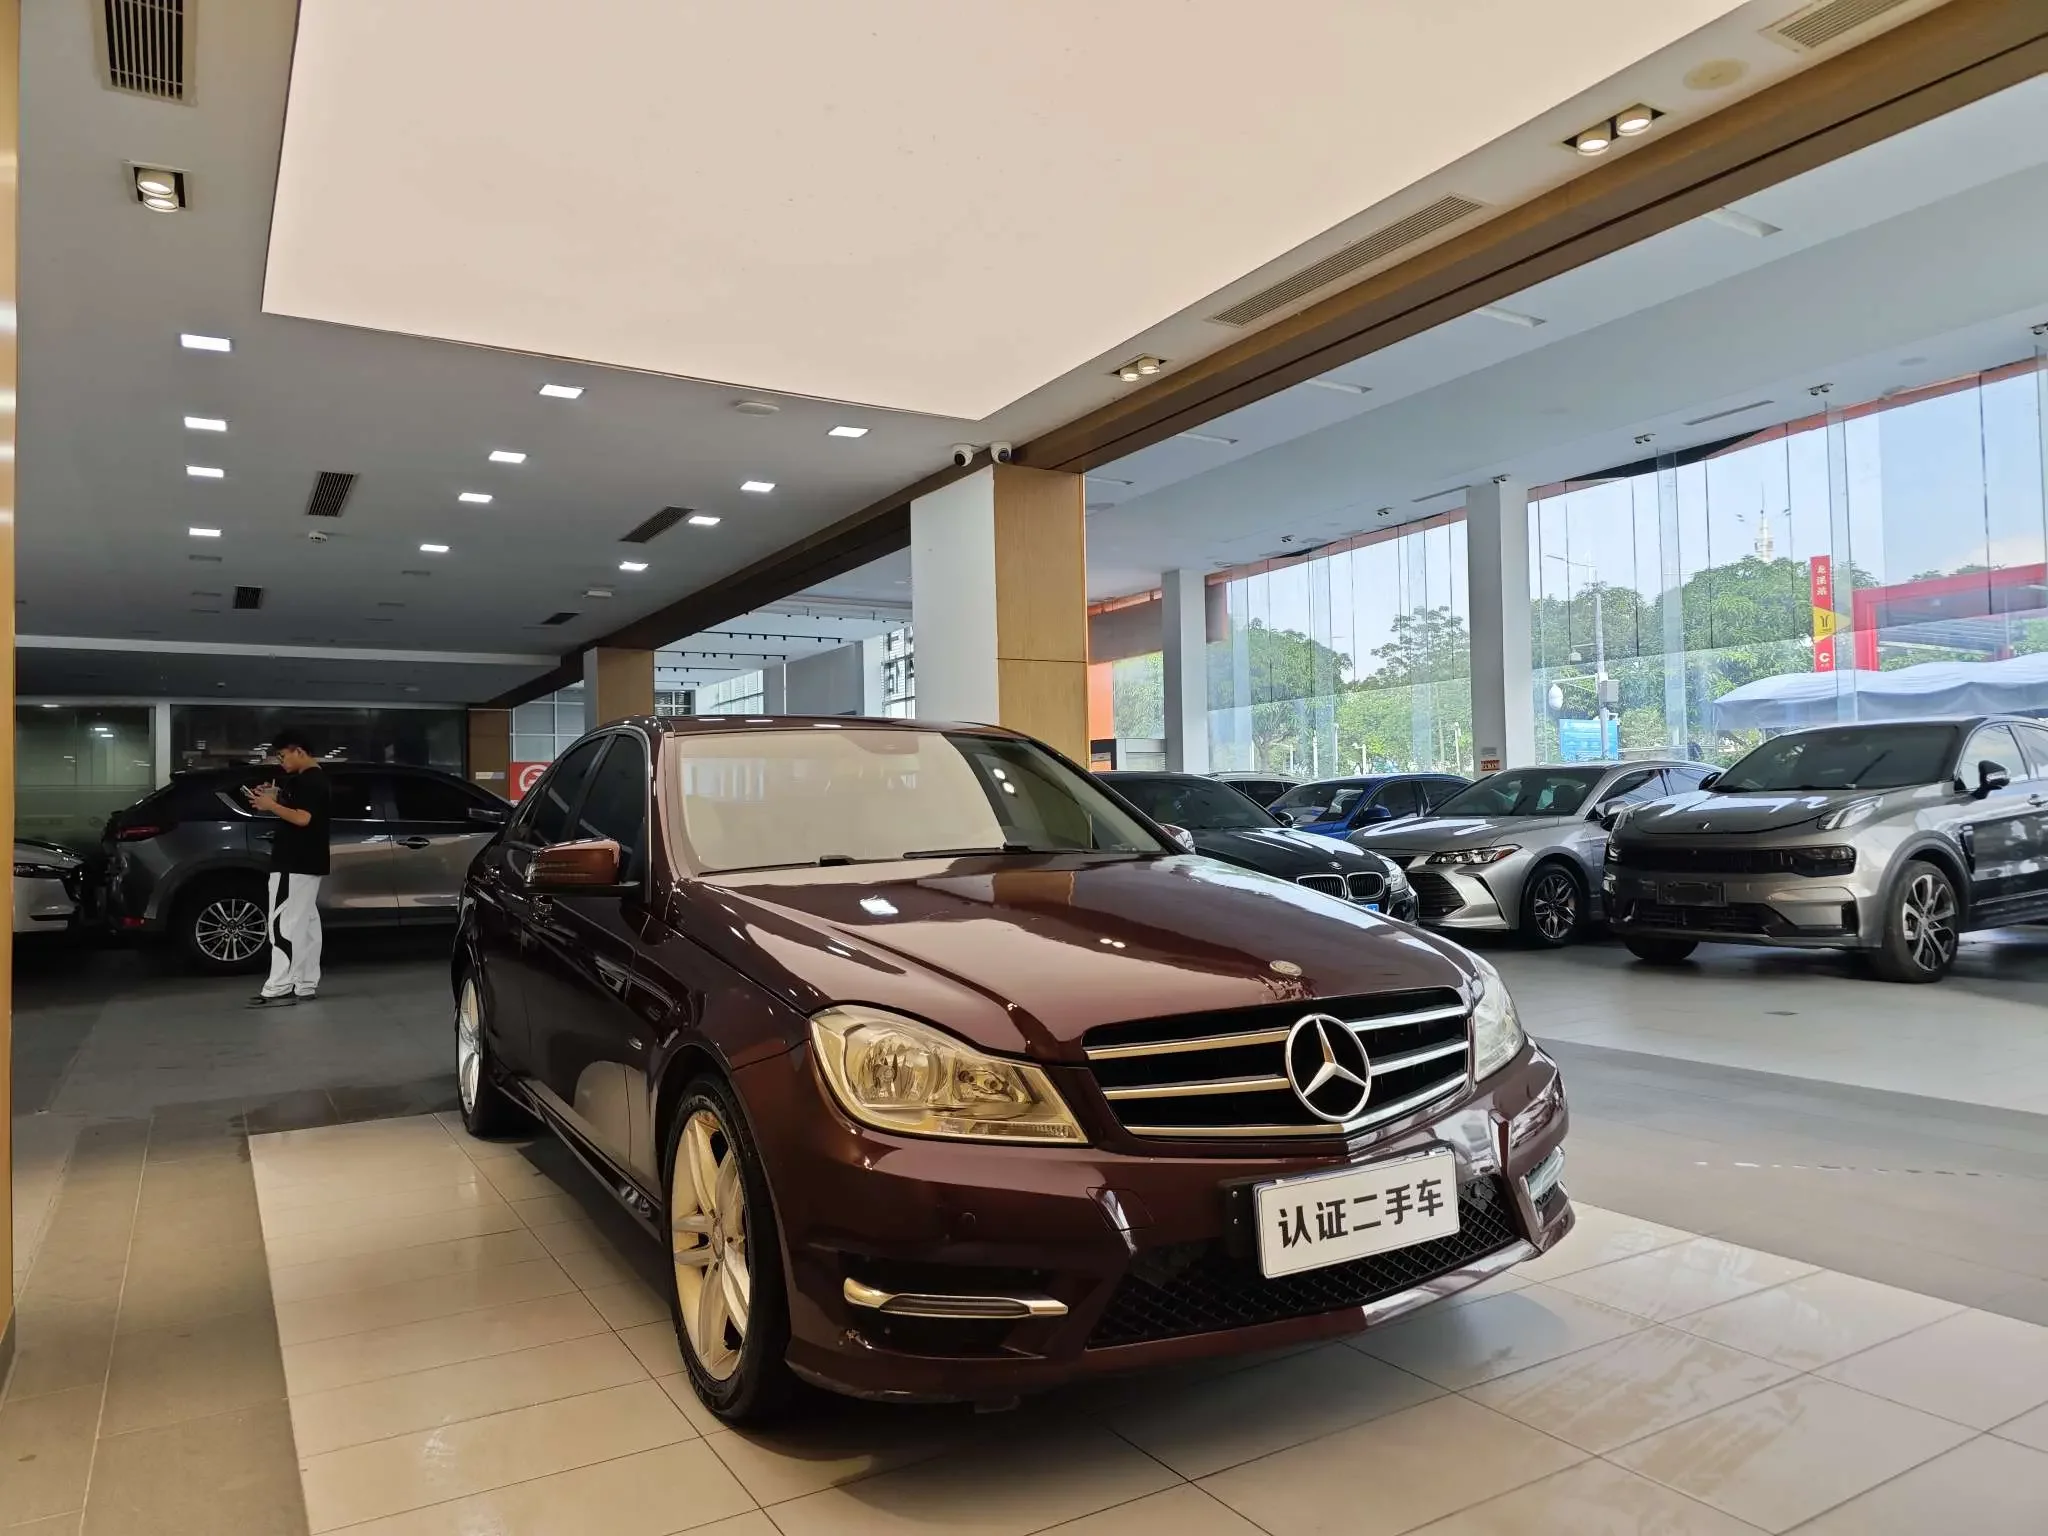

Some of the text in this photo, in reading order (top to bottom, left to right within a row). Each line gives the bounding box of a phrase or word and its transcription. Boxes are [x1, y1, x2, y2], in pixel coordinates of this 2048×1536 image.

[1278, 1179, 1444, 1249] 认证二手车
